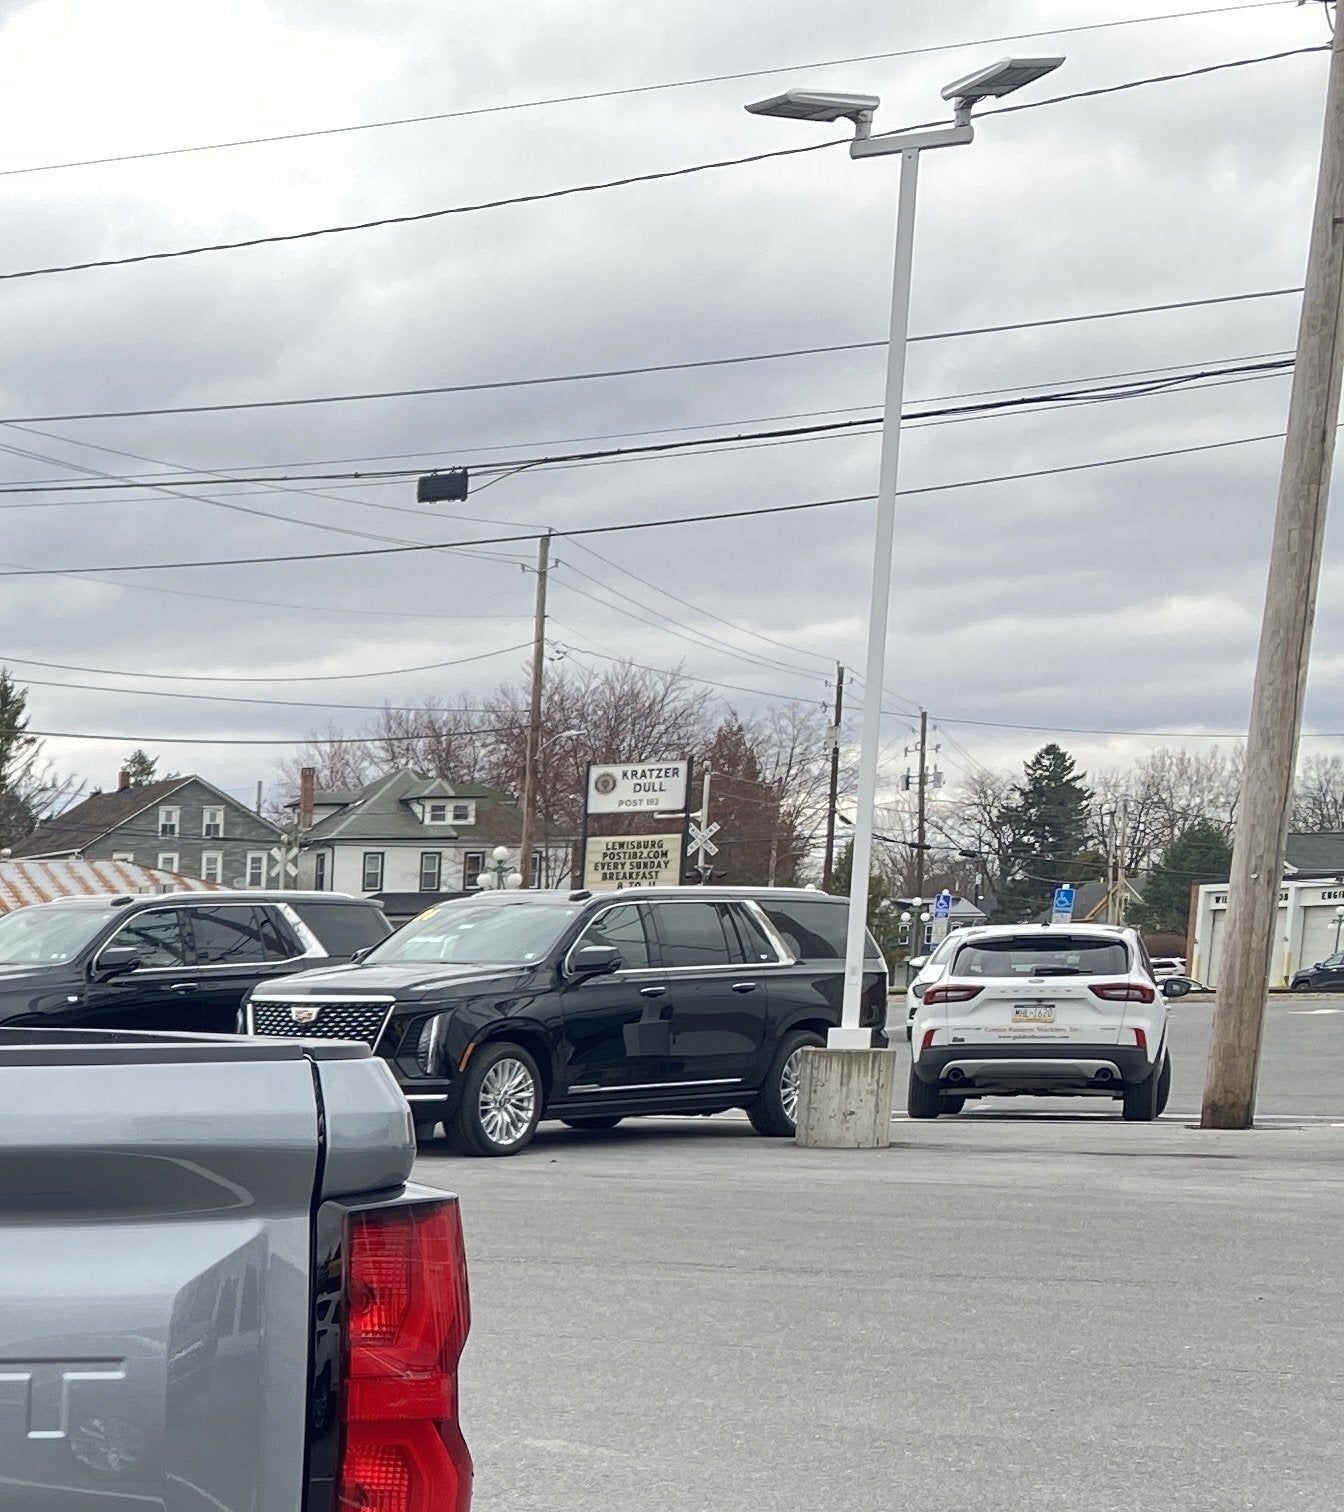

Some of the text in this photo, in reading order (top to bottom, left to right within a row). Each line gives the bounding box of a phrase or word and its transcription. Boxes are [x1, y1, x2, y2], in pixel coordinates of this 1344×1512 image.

[622, 767, 680, 780] KRATZER
[633, 781, 666, 793] DULL
[618, 798, 659, 807] POST 182
[605, 840, 664, 850] LEWISBURG
[594, 860, 670, 871] EVERY SUNDAY
[602, 871, 660, 881] BREAKFAST
